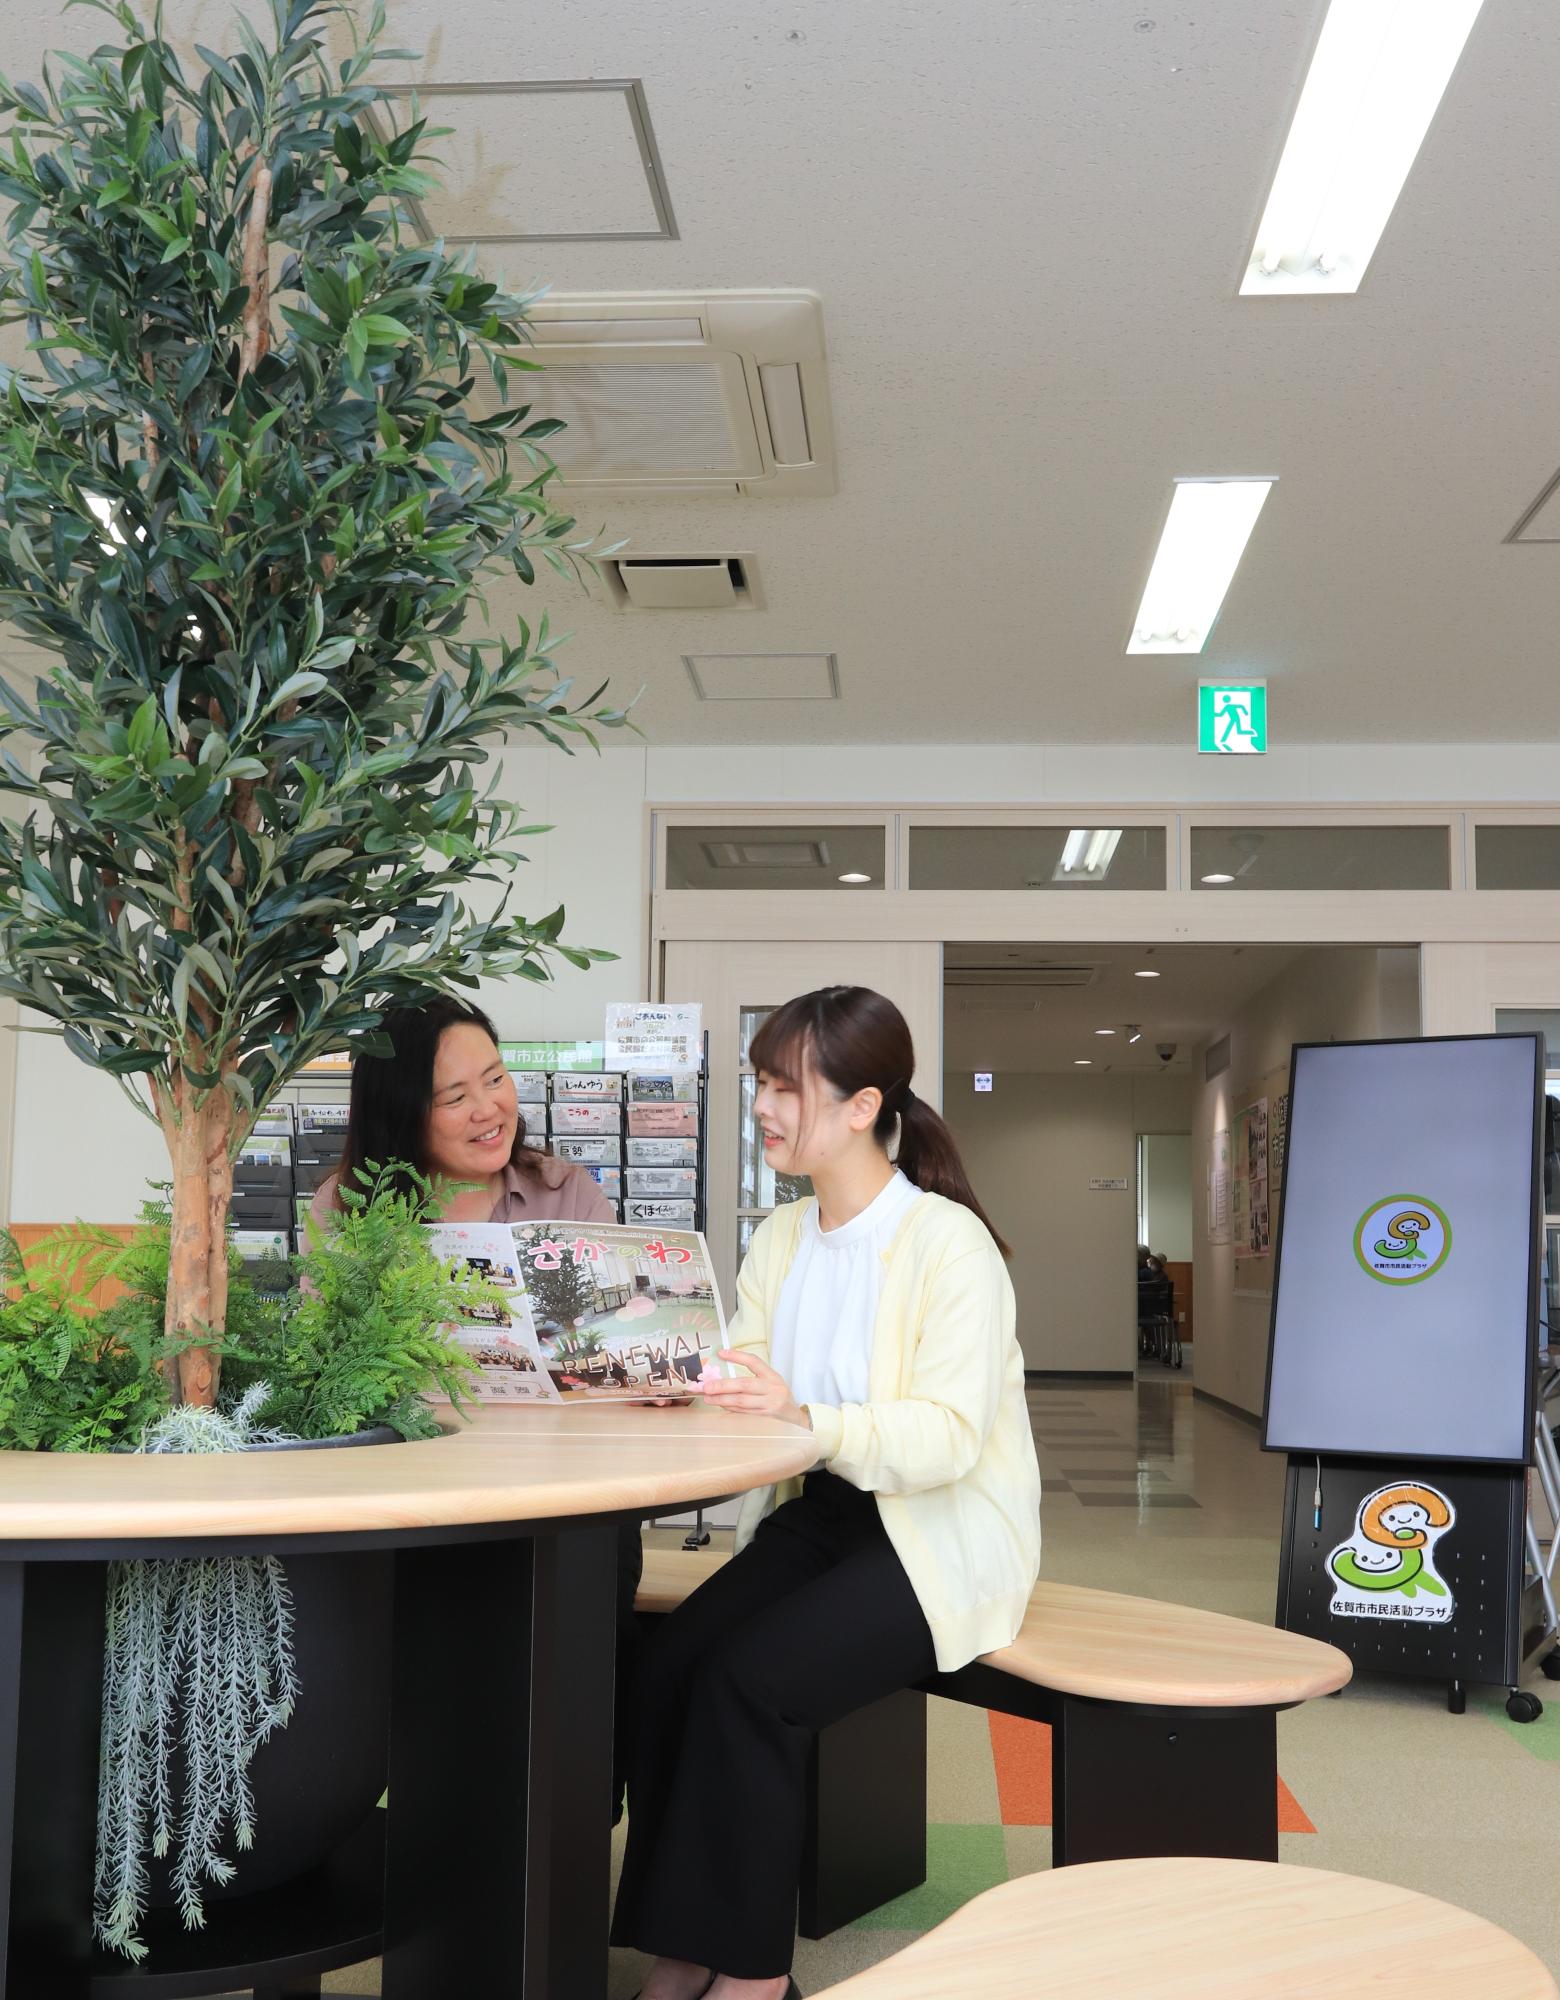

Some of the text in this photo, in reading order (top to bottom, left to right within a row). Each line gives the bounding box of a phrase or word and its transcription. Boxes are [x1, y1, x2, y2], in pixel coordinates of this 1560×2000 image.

[527, 1237, 692, 1270] さかのわ
[560, 1331, 711, 1375] RENEWAL
[600, 1365, 689, 1389] OPEN
[1332, 1601, 1448, 1618] 佐賀市市民活動プラザ
